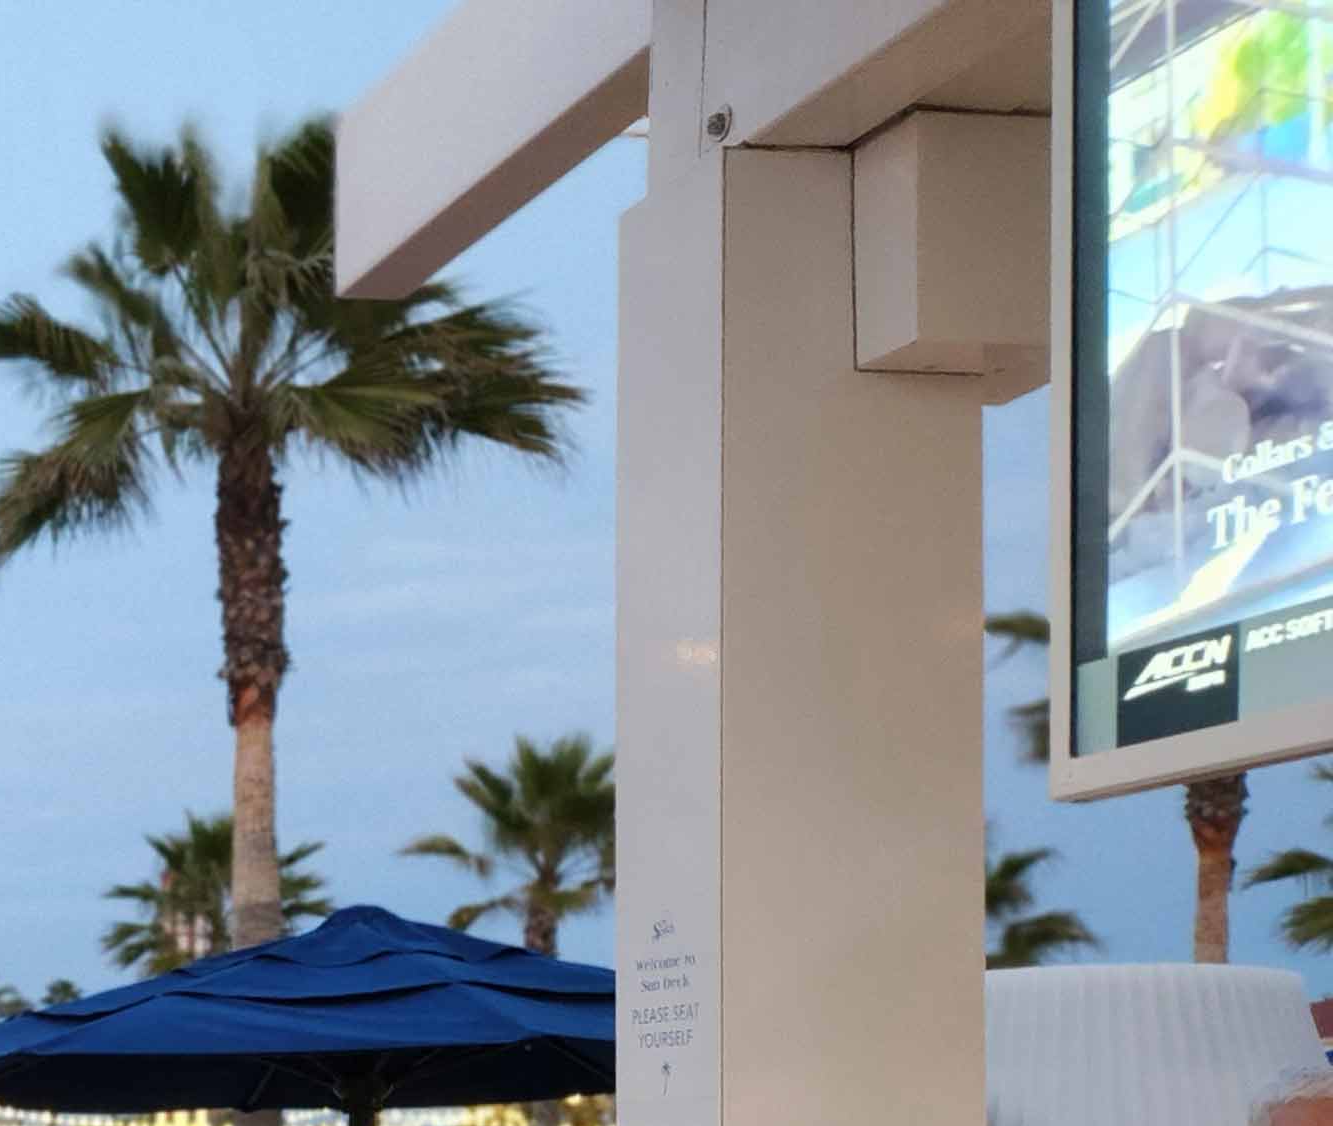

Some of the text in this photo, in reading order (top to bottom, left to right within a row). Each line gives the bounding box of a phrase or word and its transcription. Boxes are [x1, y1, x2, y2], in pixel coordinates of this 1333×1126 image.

[1206, 495, 1282, 549] The
[1245, 623, 1284, 652] ACC
[1133, 633, 1232, 687] ACCN
[632, 1002, 701, 1025] PLEASE SEAT
[638, 1029, 693, 1049] YOURSELF
